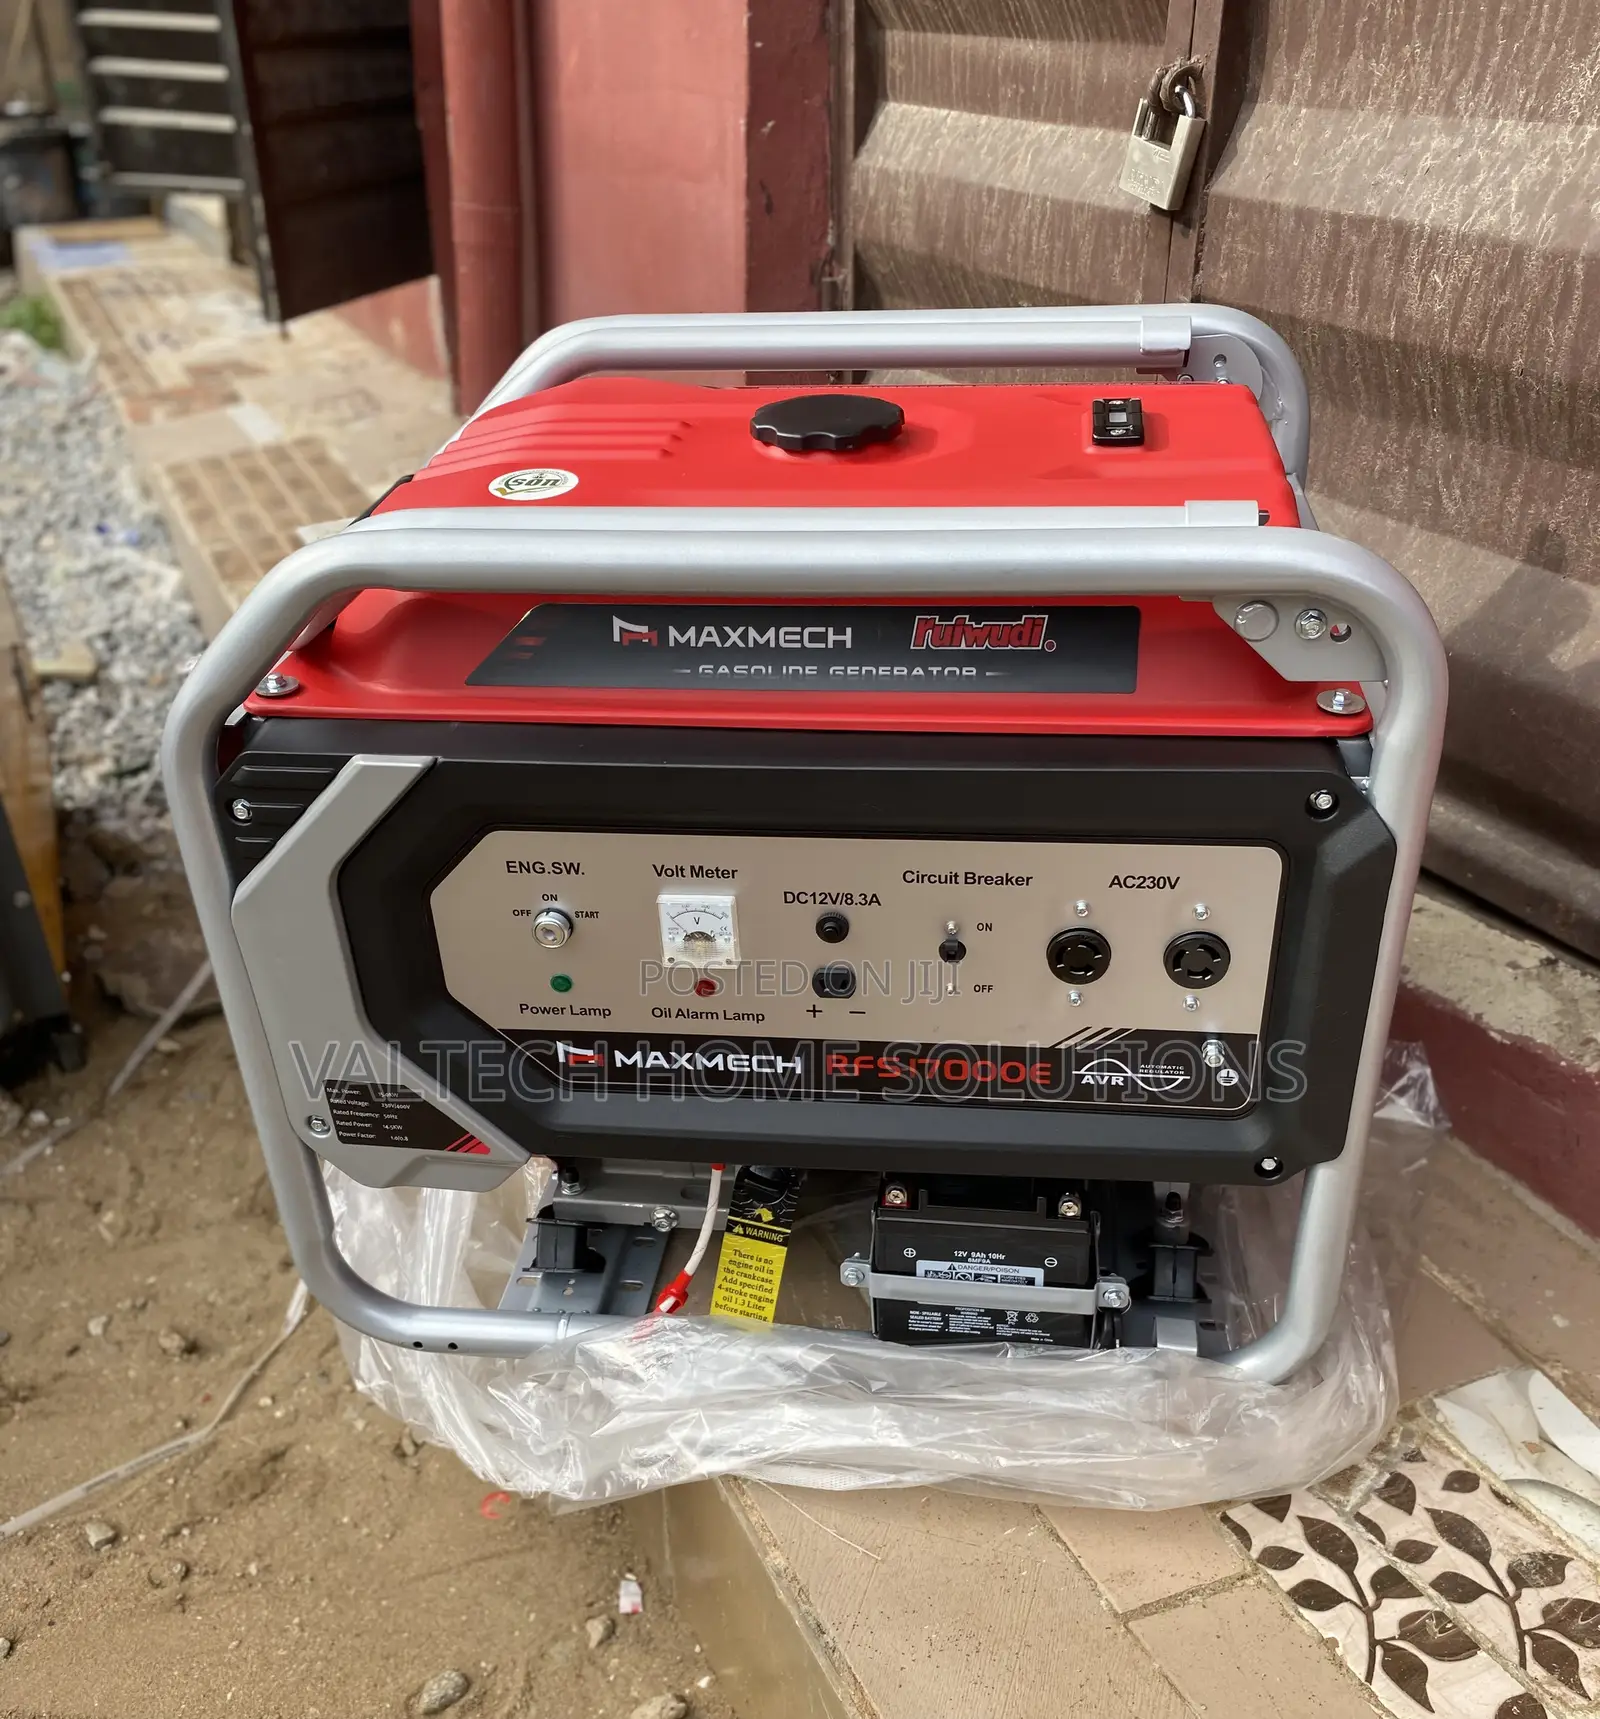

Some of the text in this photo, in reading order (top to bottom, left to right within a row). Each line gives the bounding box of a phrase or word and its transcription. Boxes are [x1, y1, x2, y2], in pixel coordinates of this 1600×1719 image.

[668, 625, 852, 649] MAXMECH
[698, 664, 977, 680] GASOLINE GENERATOR
[505, 860, 586, 875] ENG.SW.
[652, 864, 738, 879] Volt Meter
[902, 869, 1034, 887] Circuit Breaker
[1108, 874, 1181, 890] AC230V
[541, 893, 558, 902] ON
[783, 890, 882, 906] DC12V/8.3A
[512, 909, 532, 917] OFF
[574, 911, 600, 919] START
[693, 916, 700, 925] V
[976, 922, 994, 933] ON
[973, 983, 994, 994] OFF
[519, 1003, 612, 1019] Power Lamp
[651, 1006, 766, 1024] Oil Alarm Lamp
[614, 1050, 802, 1074] MAXMECH
[1081, 1075, 1125, 1086] AVR
[346, 1099, 369, 1107] Voltage:
[350, 1110, 380, 1118] Frequency:
[745, 1226, 783, 1242] WARNING
[733, 1249, 755, 1261] There
[970, 1251, 986, 1259] 9Ah
[987, 1252, 1006, 1260] 10Hr
[728, 1259, 774, 1275] engine oil in
[957, 1264, 1020, 1274] DANGER/POISON
[723, 1266, 775, 1286] the crankcase.
[722, 1276, 773, 1294] Add specified
[717, 1283, 774, 1304] 4-stroke engine
[714, 1300, 769, 1322] before starting.
[722, 1295, 766, 1311] oil 1.3 Liter
